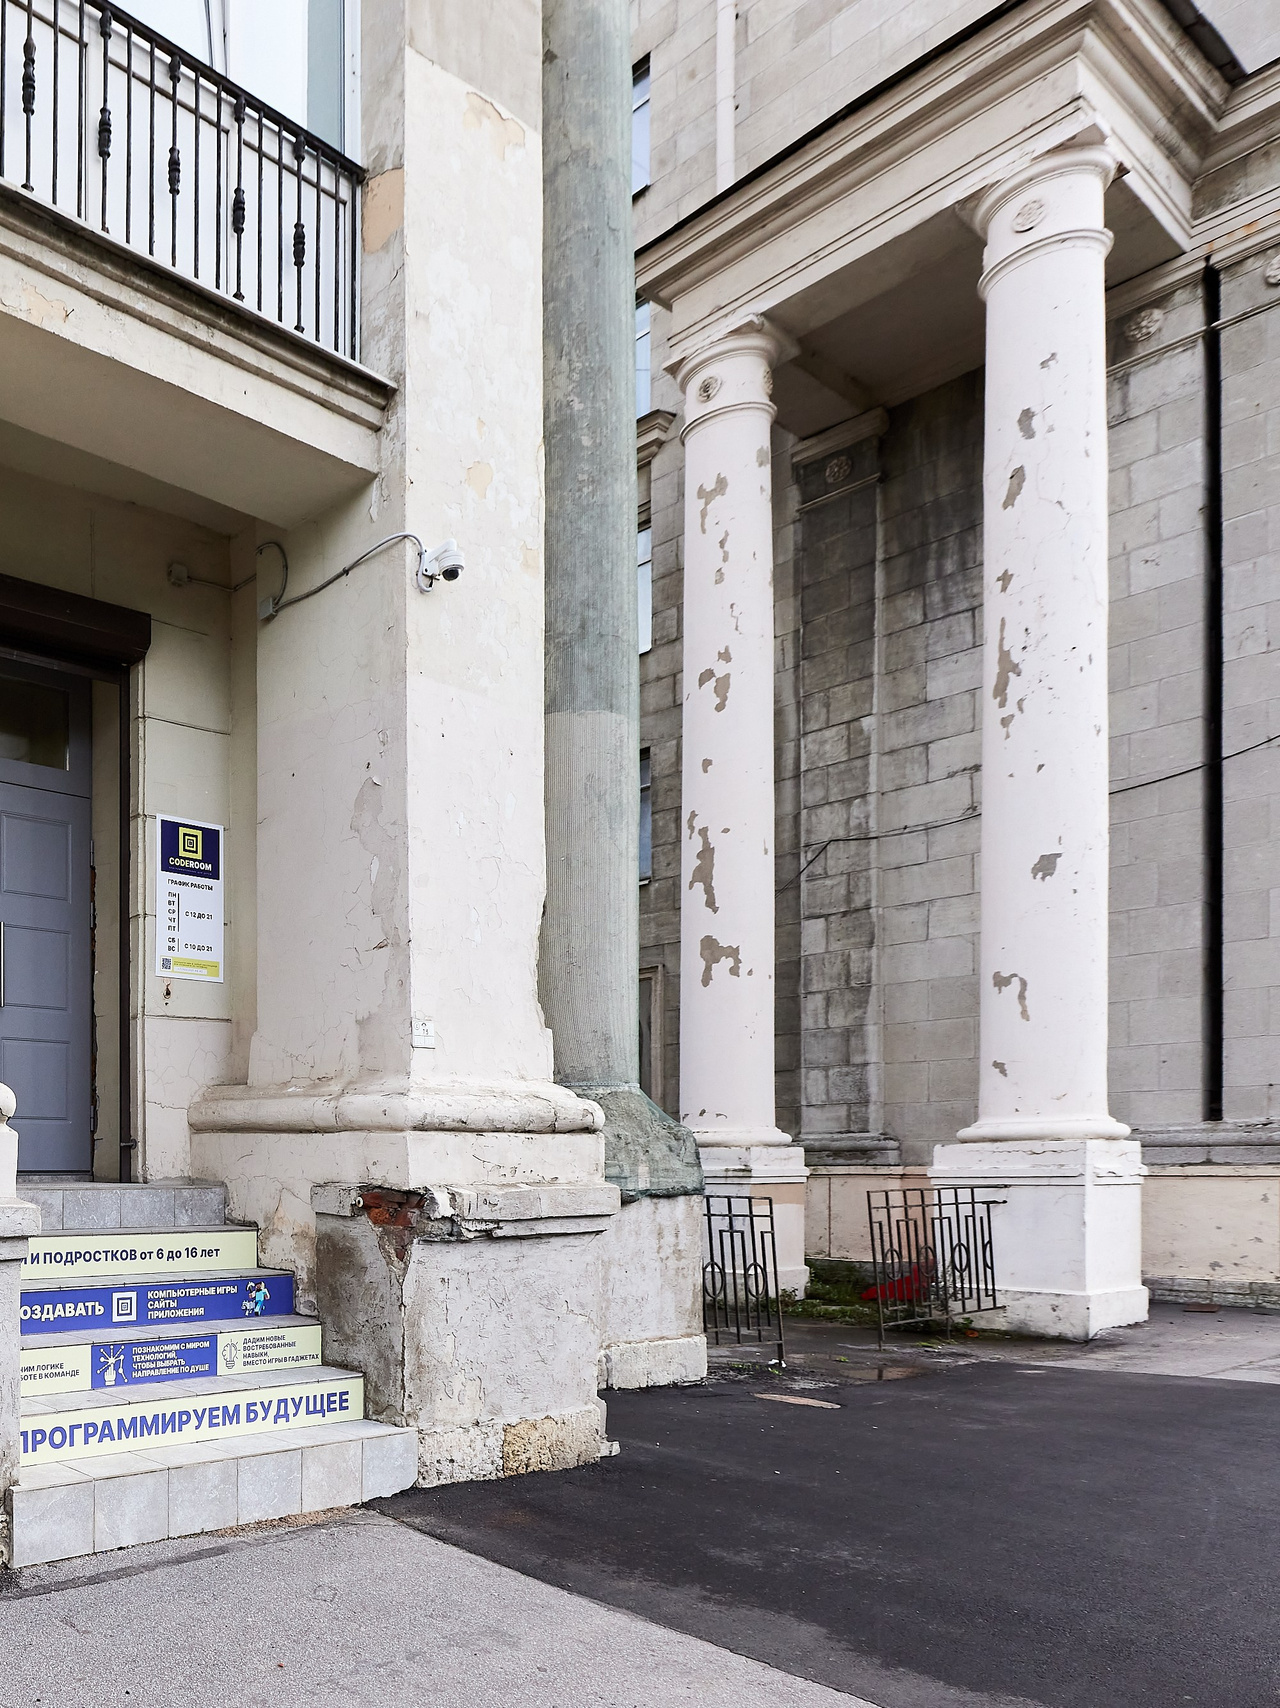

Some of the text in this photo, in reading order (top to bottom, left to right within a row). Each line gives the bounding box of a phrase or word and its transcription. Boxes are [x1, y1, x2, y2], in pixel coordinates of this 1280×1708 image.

[169, 857, 212, 871] CODEROOM
[168, 879, 213, 891] ГРАФИК РАБОТЫ
[31, 1252, 40, 1264] И
[44, 1249, 137, 1266] ПОДРОСТКОВ
[140, 1251, 153, 1260] от
[156, 1248, 164, 1259] 6
[167, 1250, 182, 1261] до
[185, 1247, 198, 1258] 16
[200, 1248, 220, 1258] лет
[148, 1286, 238, 1299] КОМПЬЮТЕРНЫЕ ИГРЫ
[148, 1299, 177, 1309] САЙТЫ
[148, 1308, 204, 1319] ПРИЛОЖЕНИЯ
[243, 1337, 265, 1345] ДАДИМ
[243, 1341, 296, 1351] ВОСТРЕБОВАННЫЕ
[132, 1344, 180, 1354] ПОЗНАКОМИМ
[186, 1341, 210, 1349] МИРОМ
[133, 1351, 177, 1362] ТЕХНОЛОГИЙ,
[288, 1354, 319, 1362] ГАДЖЕТАХ
[36, 1363, 64, 1371] ЛОГИКЕ
[132, 1359, 185, 1370] ЧТОБЫ ВЫБРАТЬ
[44, 1369, 79, 1379] КОМАНДЕ
[132, 1367, 179, 1378] НАПРАВЛЕНИЕ
[190, 1364, 209, 1373] ДУШЕ
[246, 1391, 349, 1424] БУДУЩЕЕ
